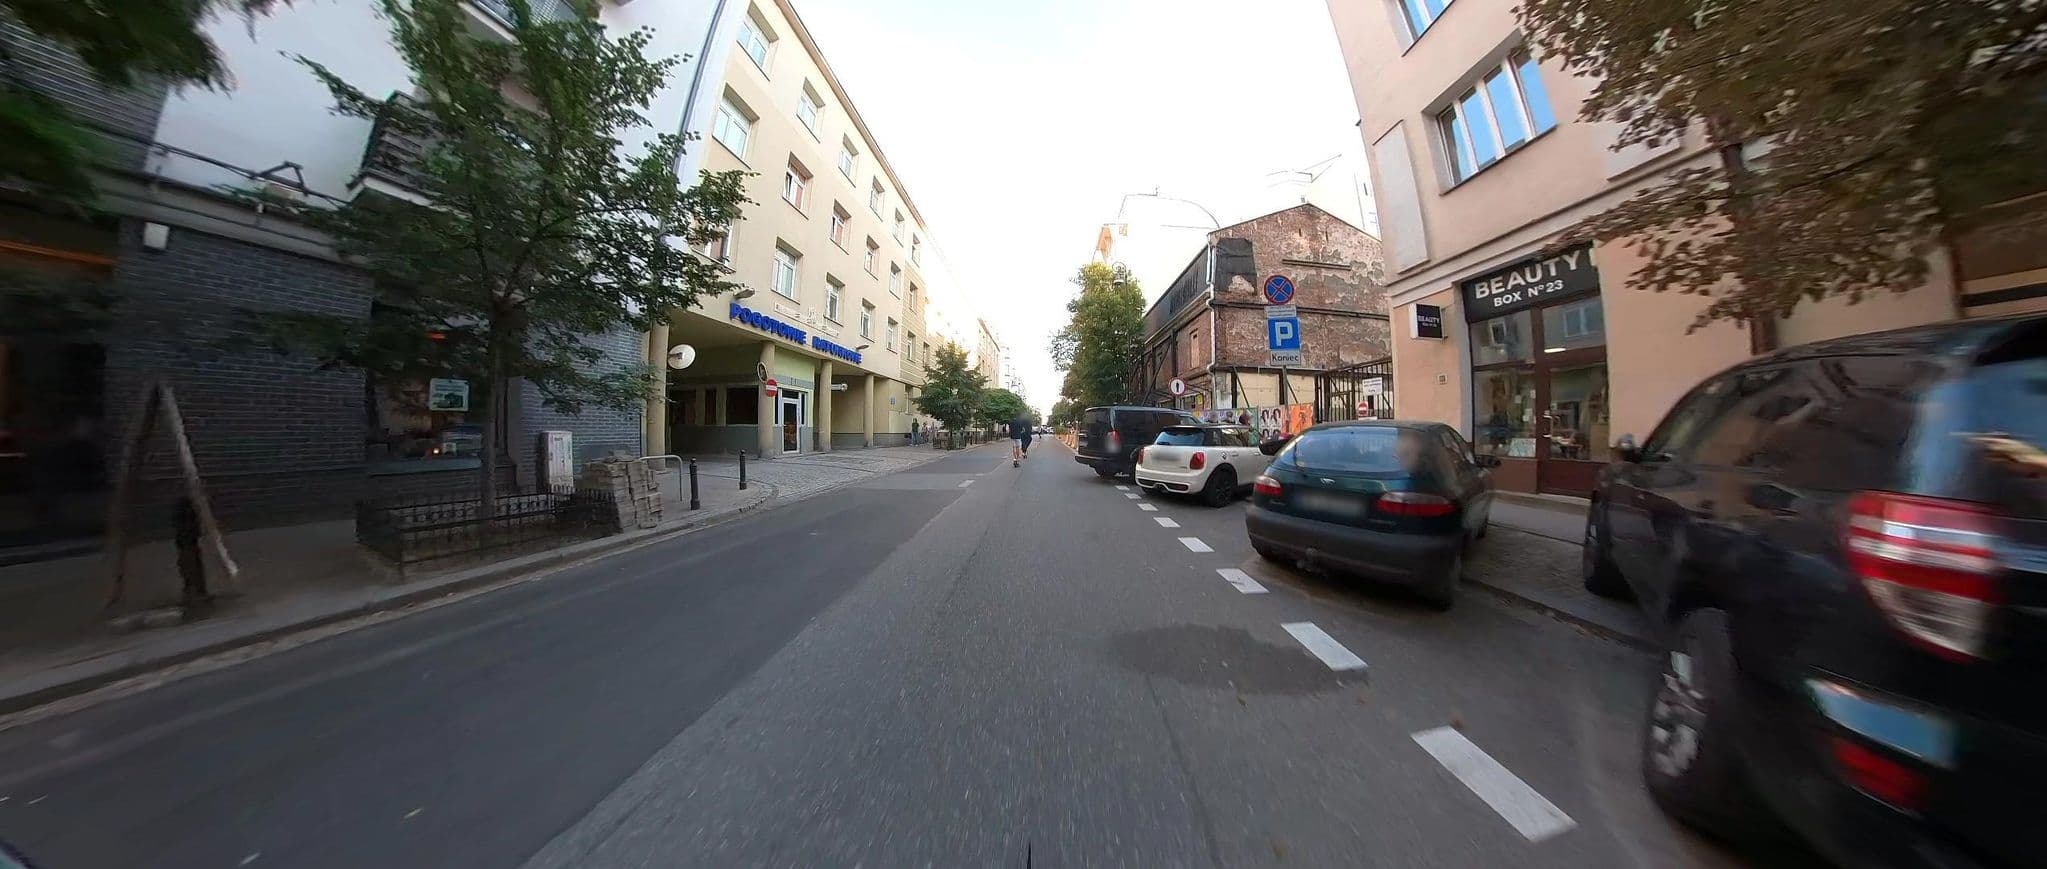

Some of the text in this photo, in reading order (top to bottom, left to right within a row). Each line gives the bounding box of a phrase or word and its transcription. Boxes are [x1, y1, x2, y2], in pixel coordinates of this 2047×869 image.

[1474, 250, 1580, 299] BEAUTY
[1494, 291, 1522, 307] BOX
[1275, 321, 1294, 346] P
[1272, 353, 1299, 362] Koniec
